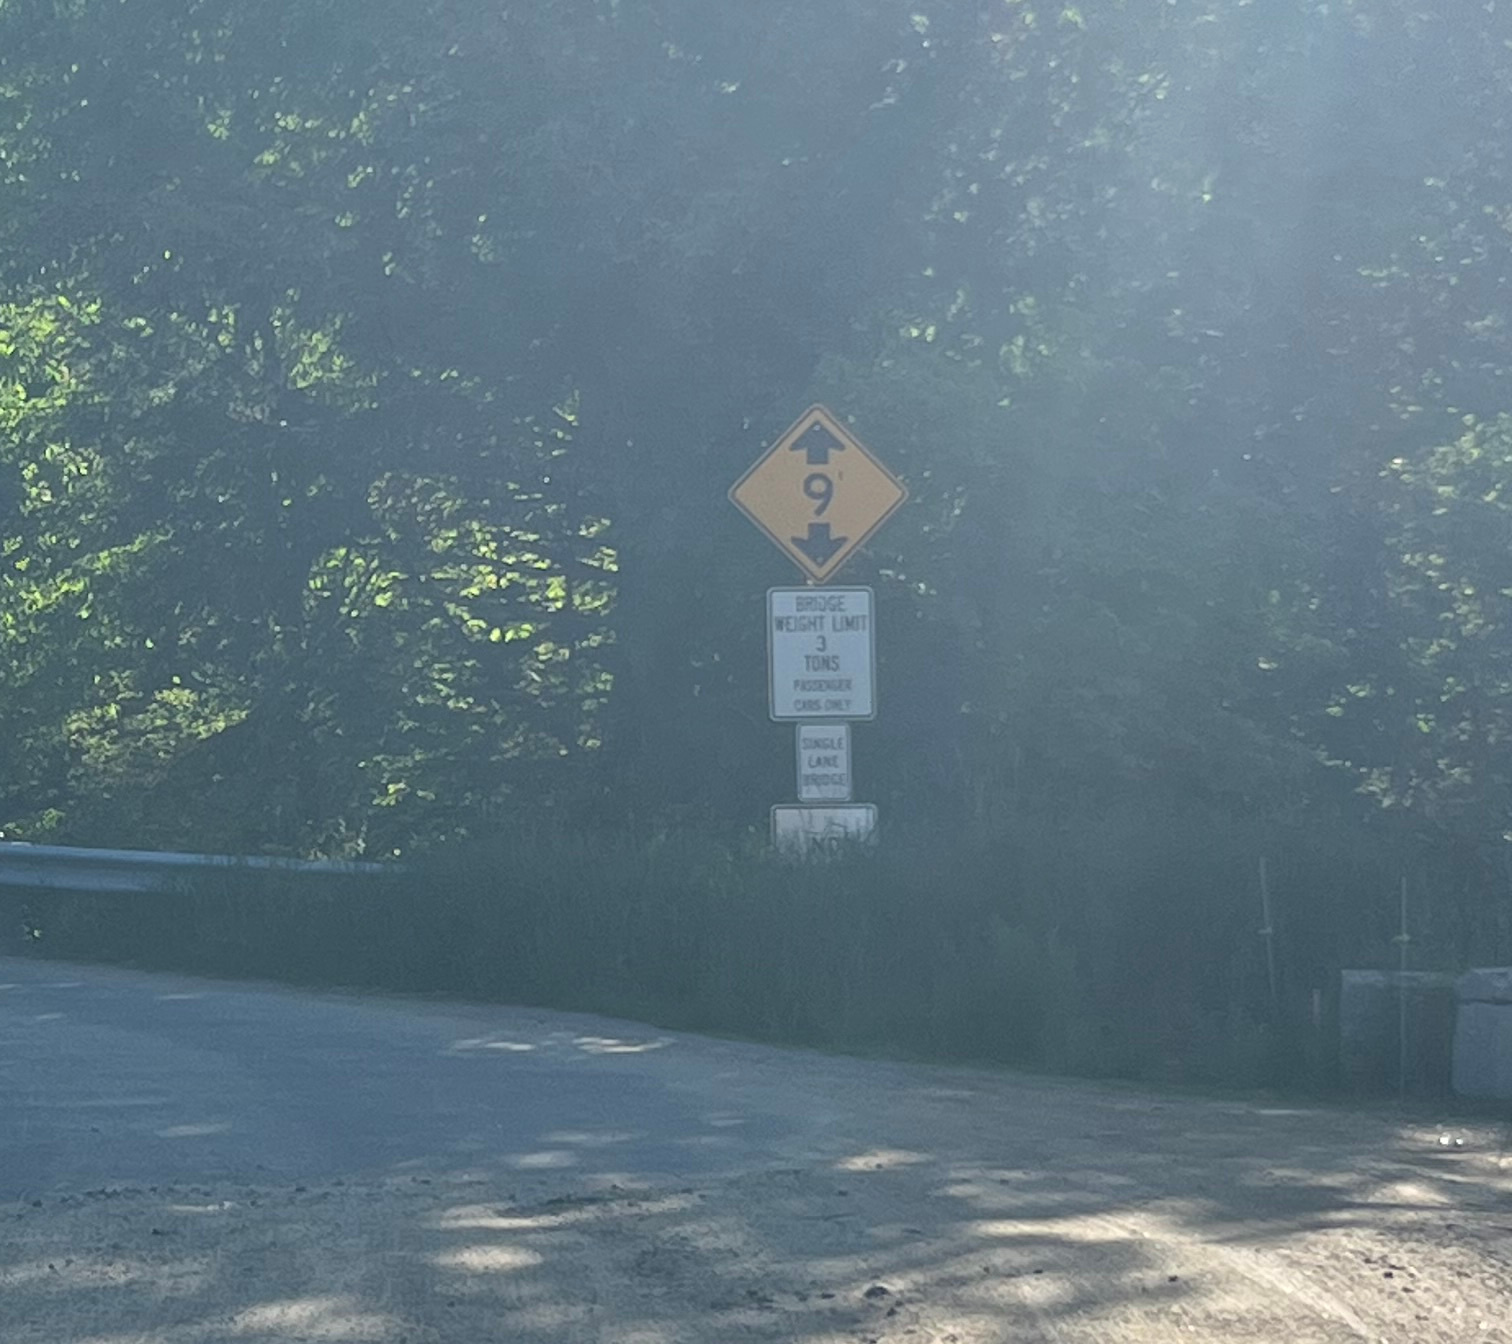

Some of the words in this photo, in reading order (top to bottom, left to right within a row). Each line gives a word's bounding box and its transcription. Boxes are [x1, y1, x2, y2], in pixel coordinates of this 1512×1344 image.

[796, 595, 846, 612] BRIDGE
[775, 615, 825, 632] WEIGHT
[832, 615, 867, 632] LIMIT
[815, 635, 827, 653] 3
[804, 655, 840, 672] TONS
[793, 679, 852, 692] PASSENGER
[793, 699, 821, 712] CARS
[823, 698, 852, 712] ONLY
[802, 737, 844, 751] SINGLE
[808, 755, 839, 769] LANE
[803, 773, 846, 786] BRIDGE
